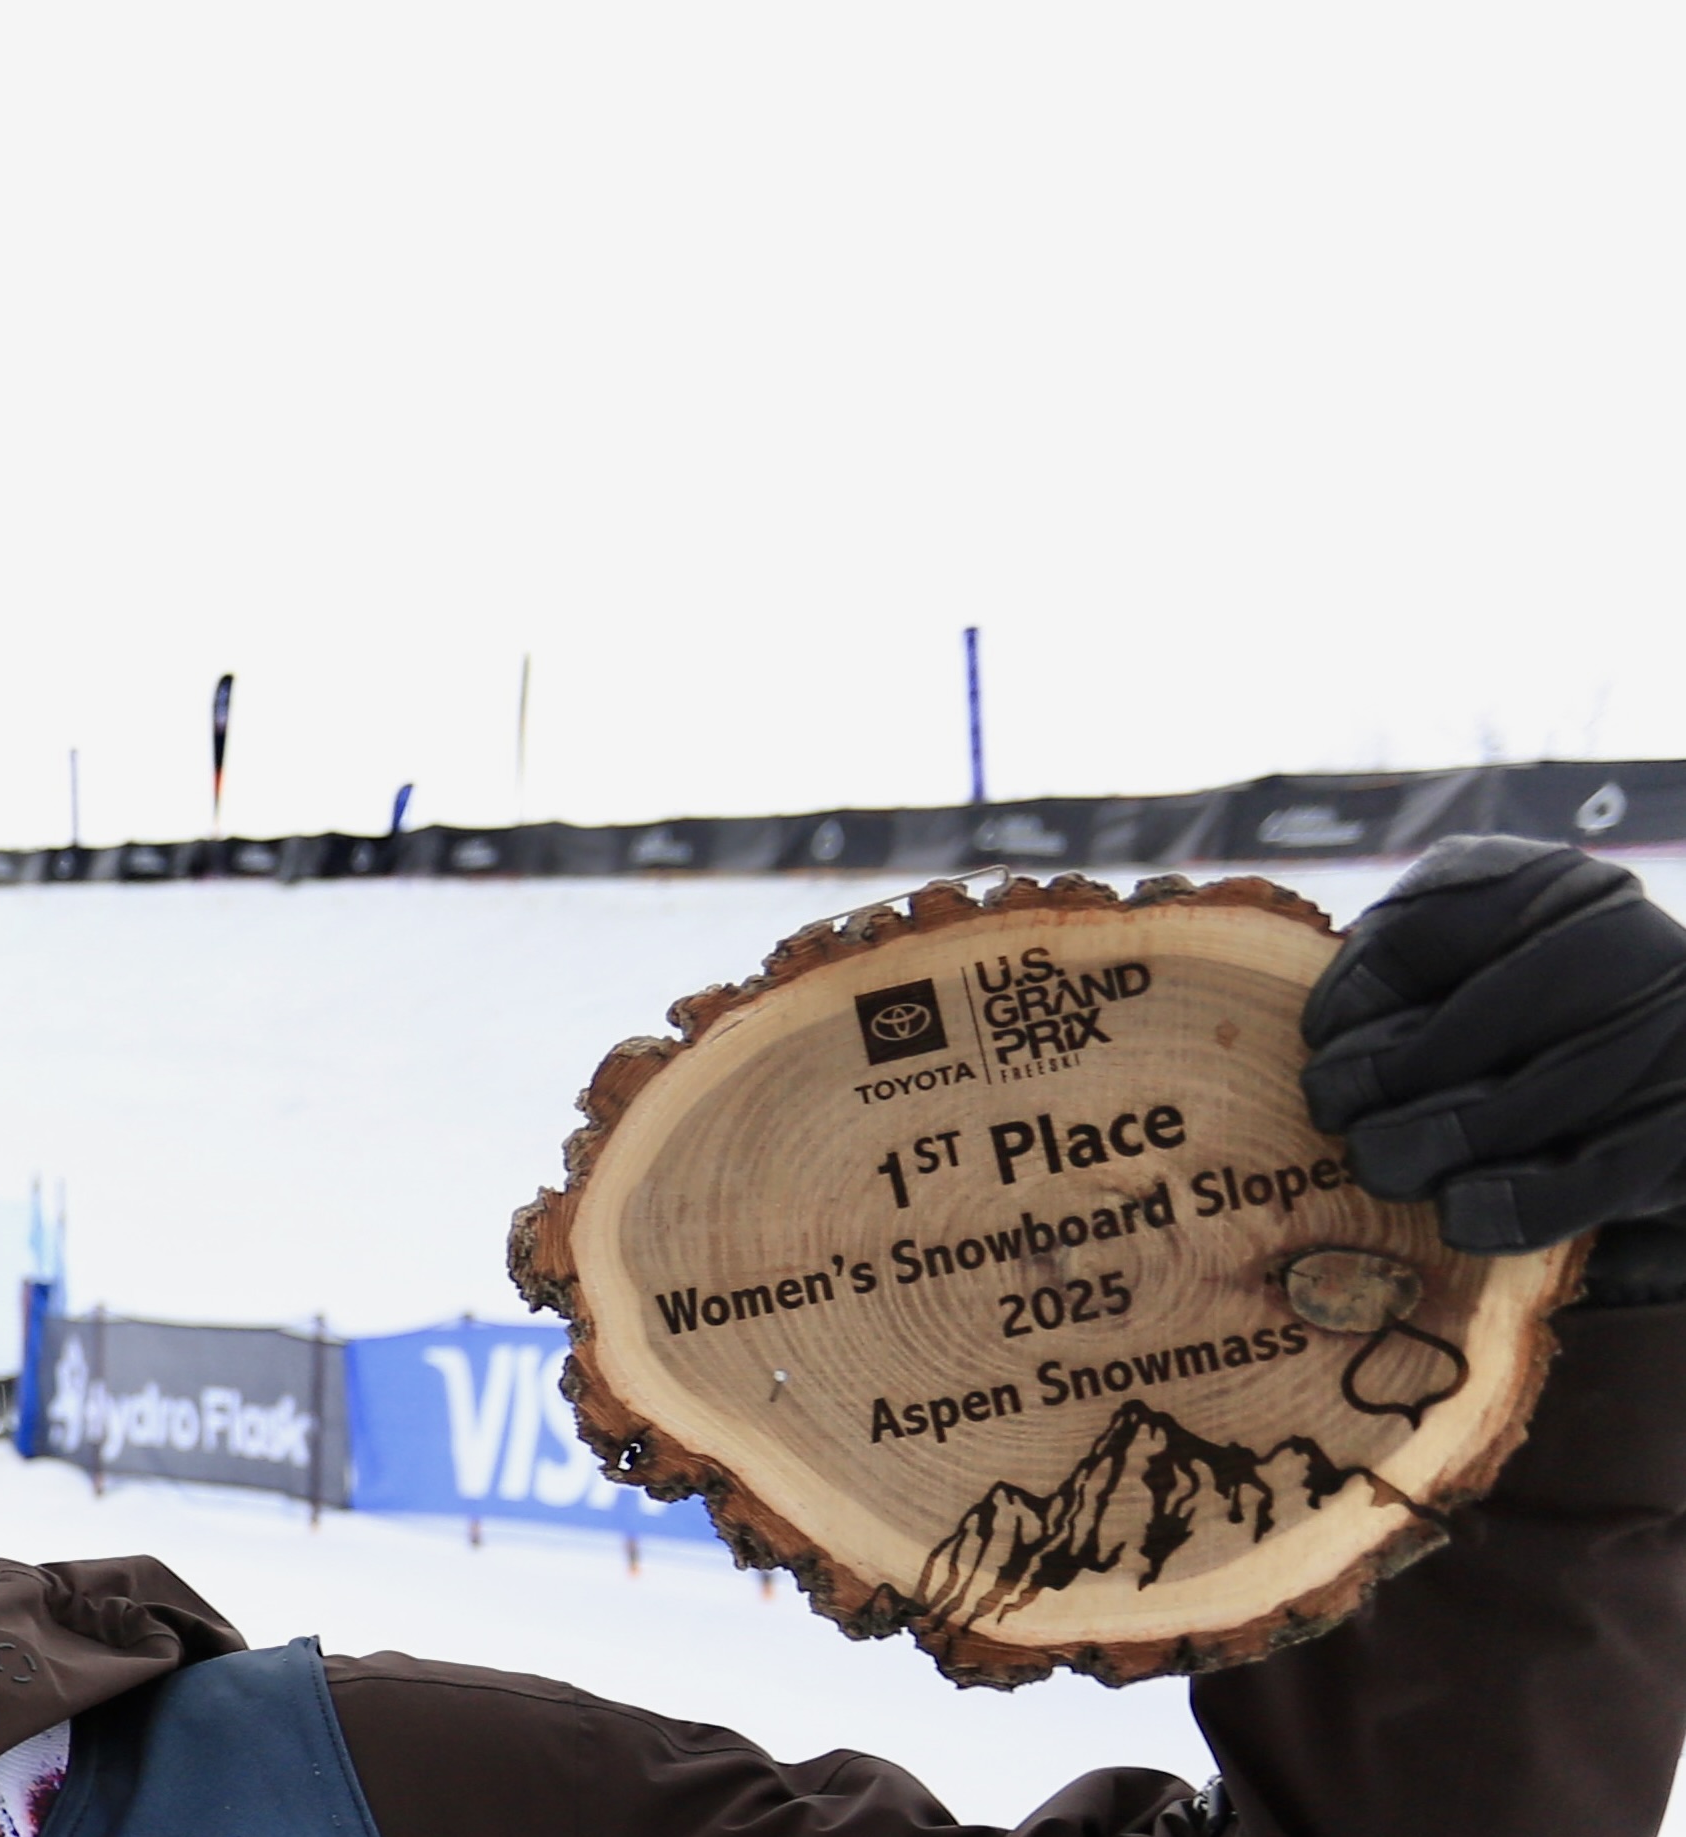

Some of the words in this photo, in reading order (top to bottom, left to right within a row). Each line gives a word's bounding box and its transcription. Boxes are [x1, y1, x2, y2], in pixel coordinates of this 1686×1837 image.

[975, 947, 1065, 993] U.S.
[983, 962, 1152, 1028] GRAND
[854, 1062, 976, 1105] TOYOTA
[1000, 1055, 1081, 1084] FREESKI
[878, 1130, 961, 1209] 1ST
[989, 1105, 1186, 1185] Place
[655, 1255, 877, 1335] Women's
[891, 1181, 1176, 1285] Snowboard
[998, 1271, 1132, 1338] 2025
[870, 1382, 1022, 1444] Aspen
[1037, 1322, 1309, 1406] Snowmass
[424, 1344, 665, 1515] VIS
